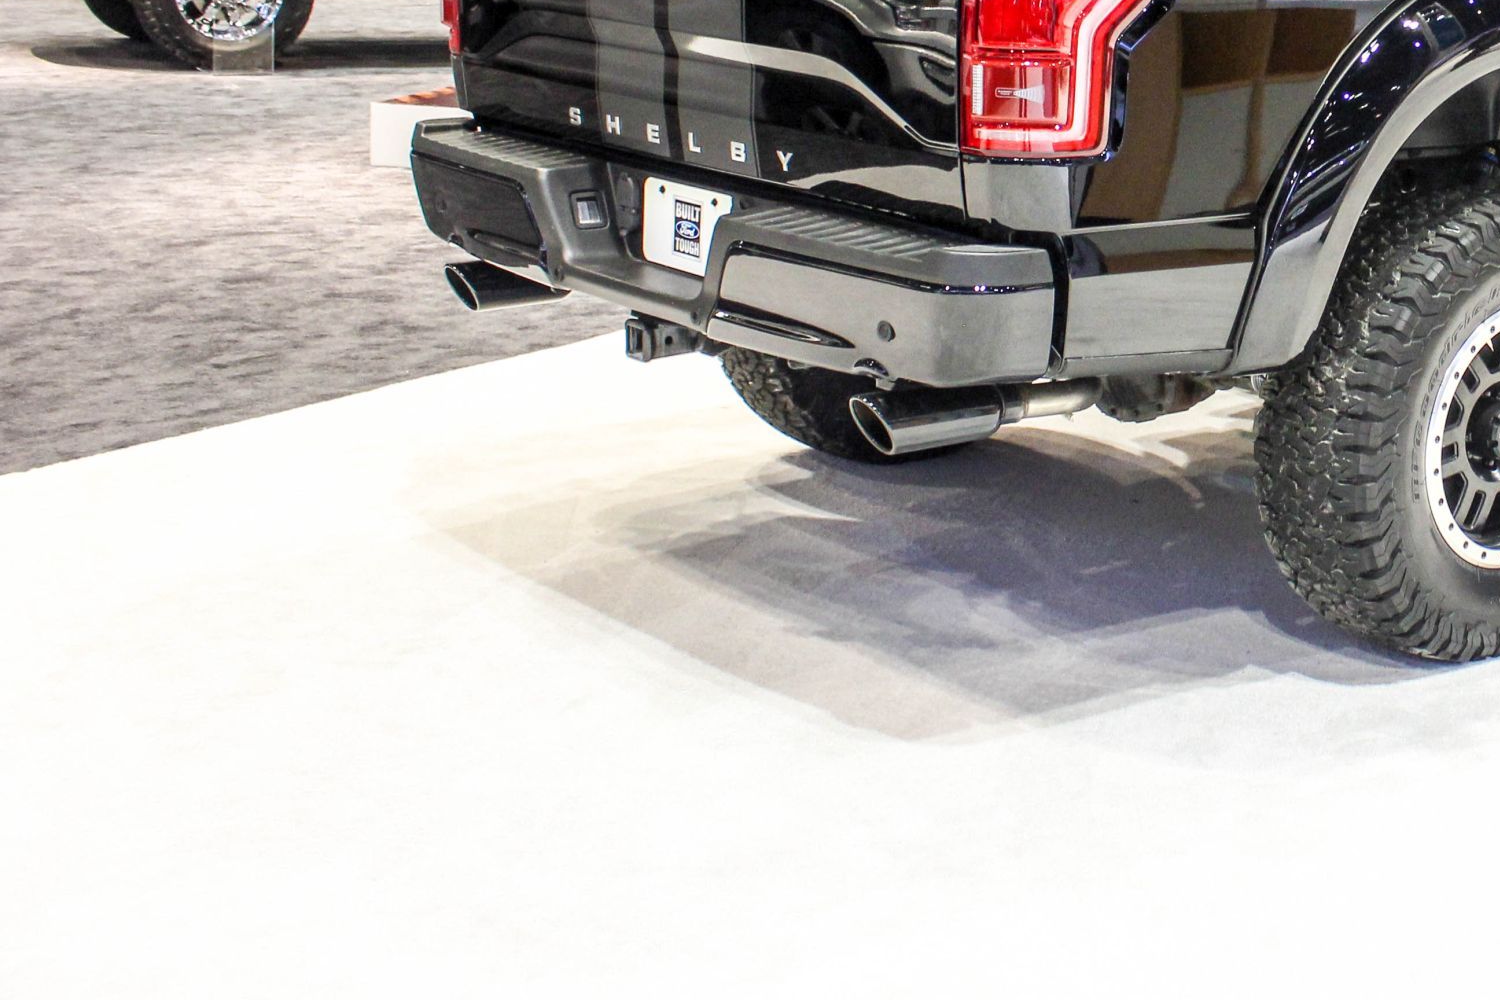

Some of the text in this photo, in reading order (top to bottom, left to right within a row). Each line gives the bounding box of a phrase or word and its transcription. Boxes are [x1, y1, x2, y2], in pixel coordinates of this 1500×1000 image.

[568, 106, 794, 173] SHELBY
[675, 201, 701, 222] BUILT
[679, 223, 696, 237] Ford
[675, 237, 700, 257] TOUGH
